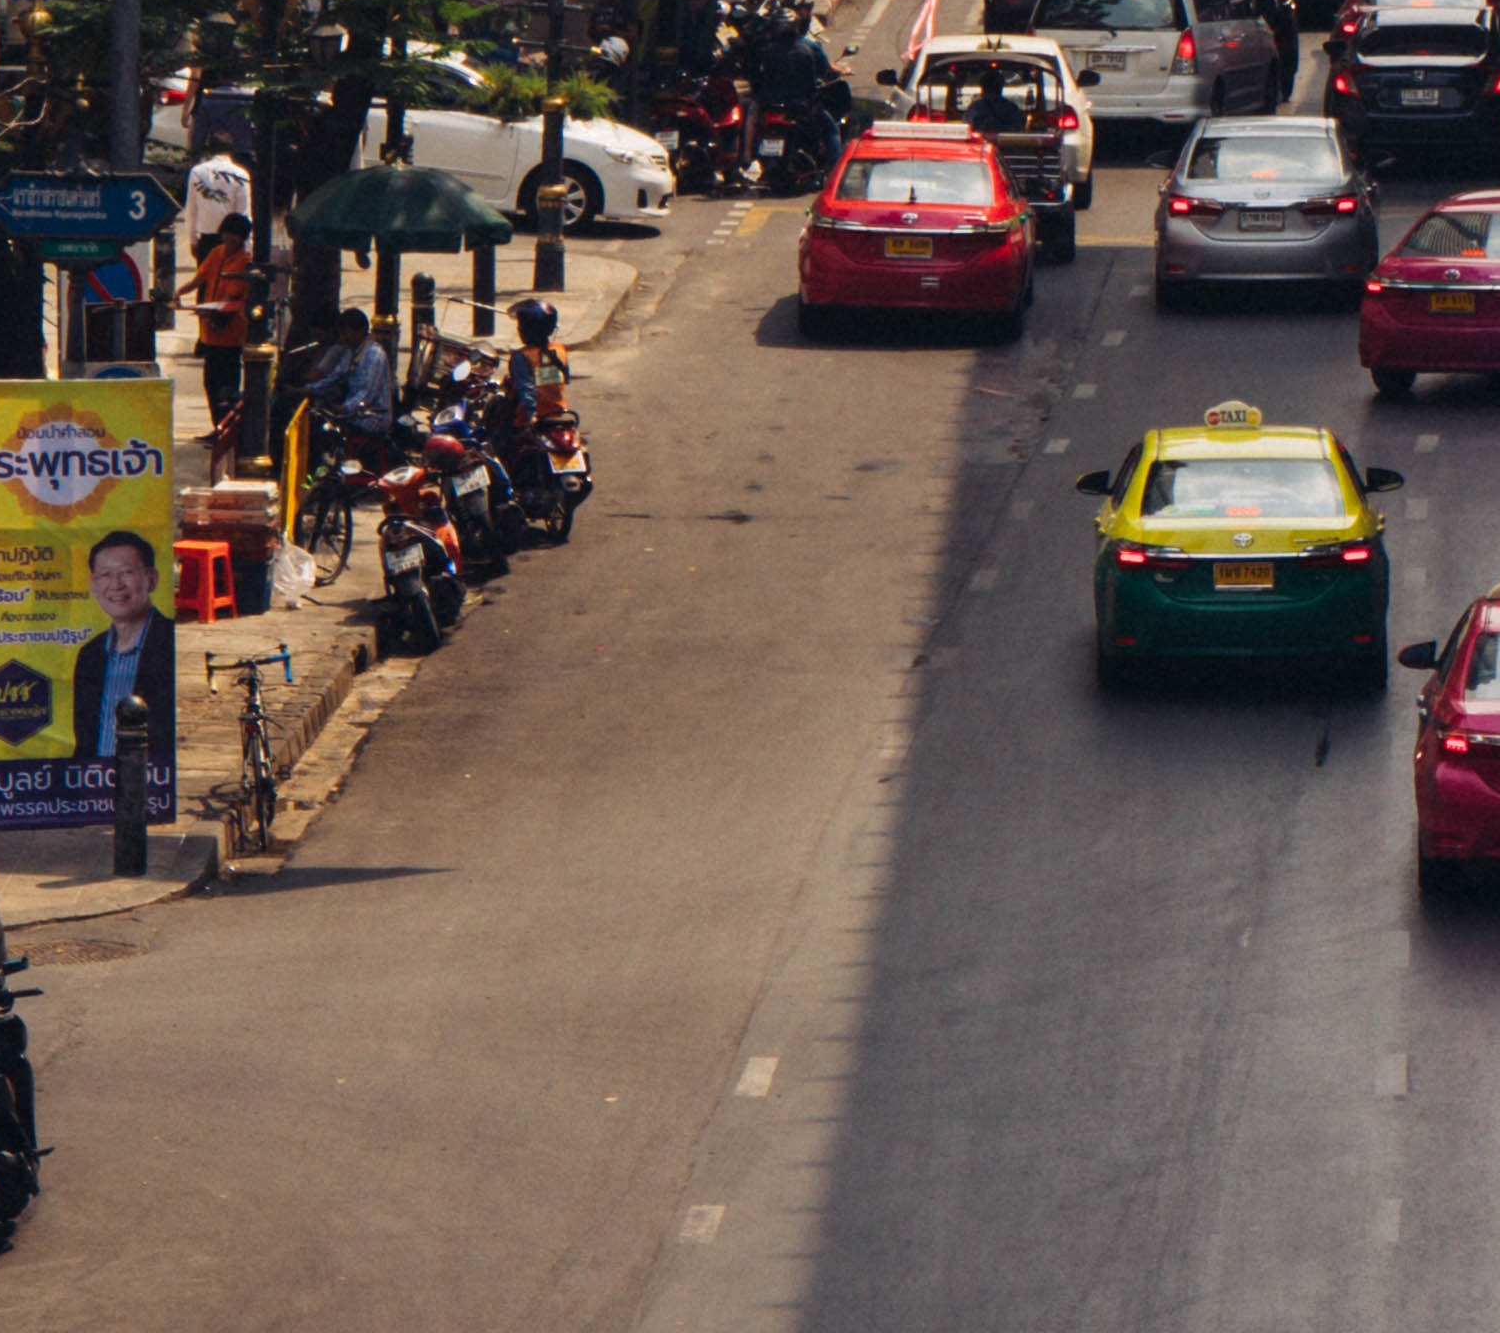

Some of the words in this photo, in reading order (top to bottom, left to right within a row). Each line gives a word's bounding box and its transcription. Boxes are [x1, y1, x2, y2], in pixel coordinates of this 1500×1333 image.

[128, 190, 147, 221] 3
[1220, 409, 1248, 423] TAXI
[16, 423, 107, 440] น้อมนำคำสอน
